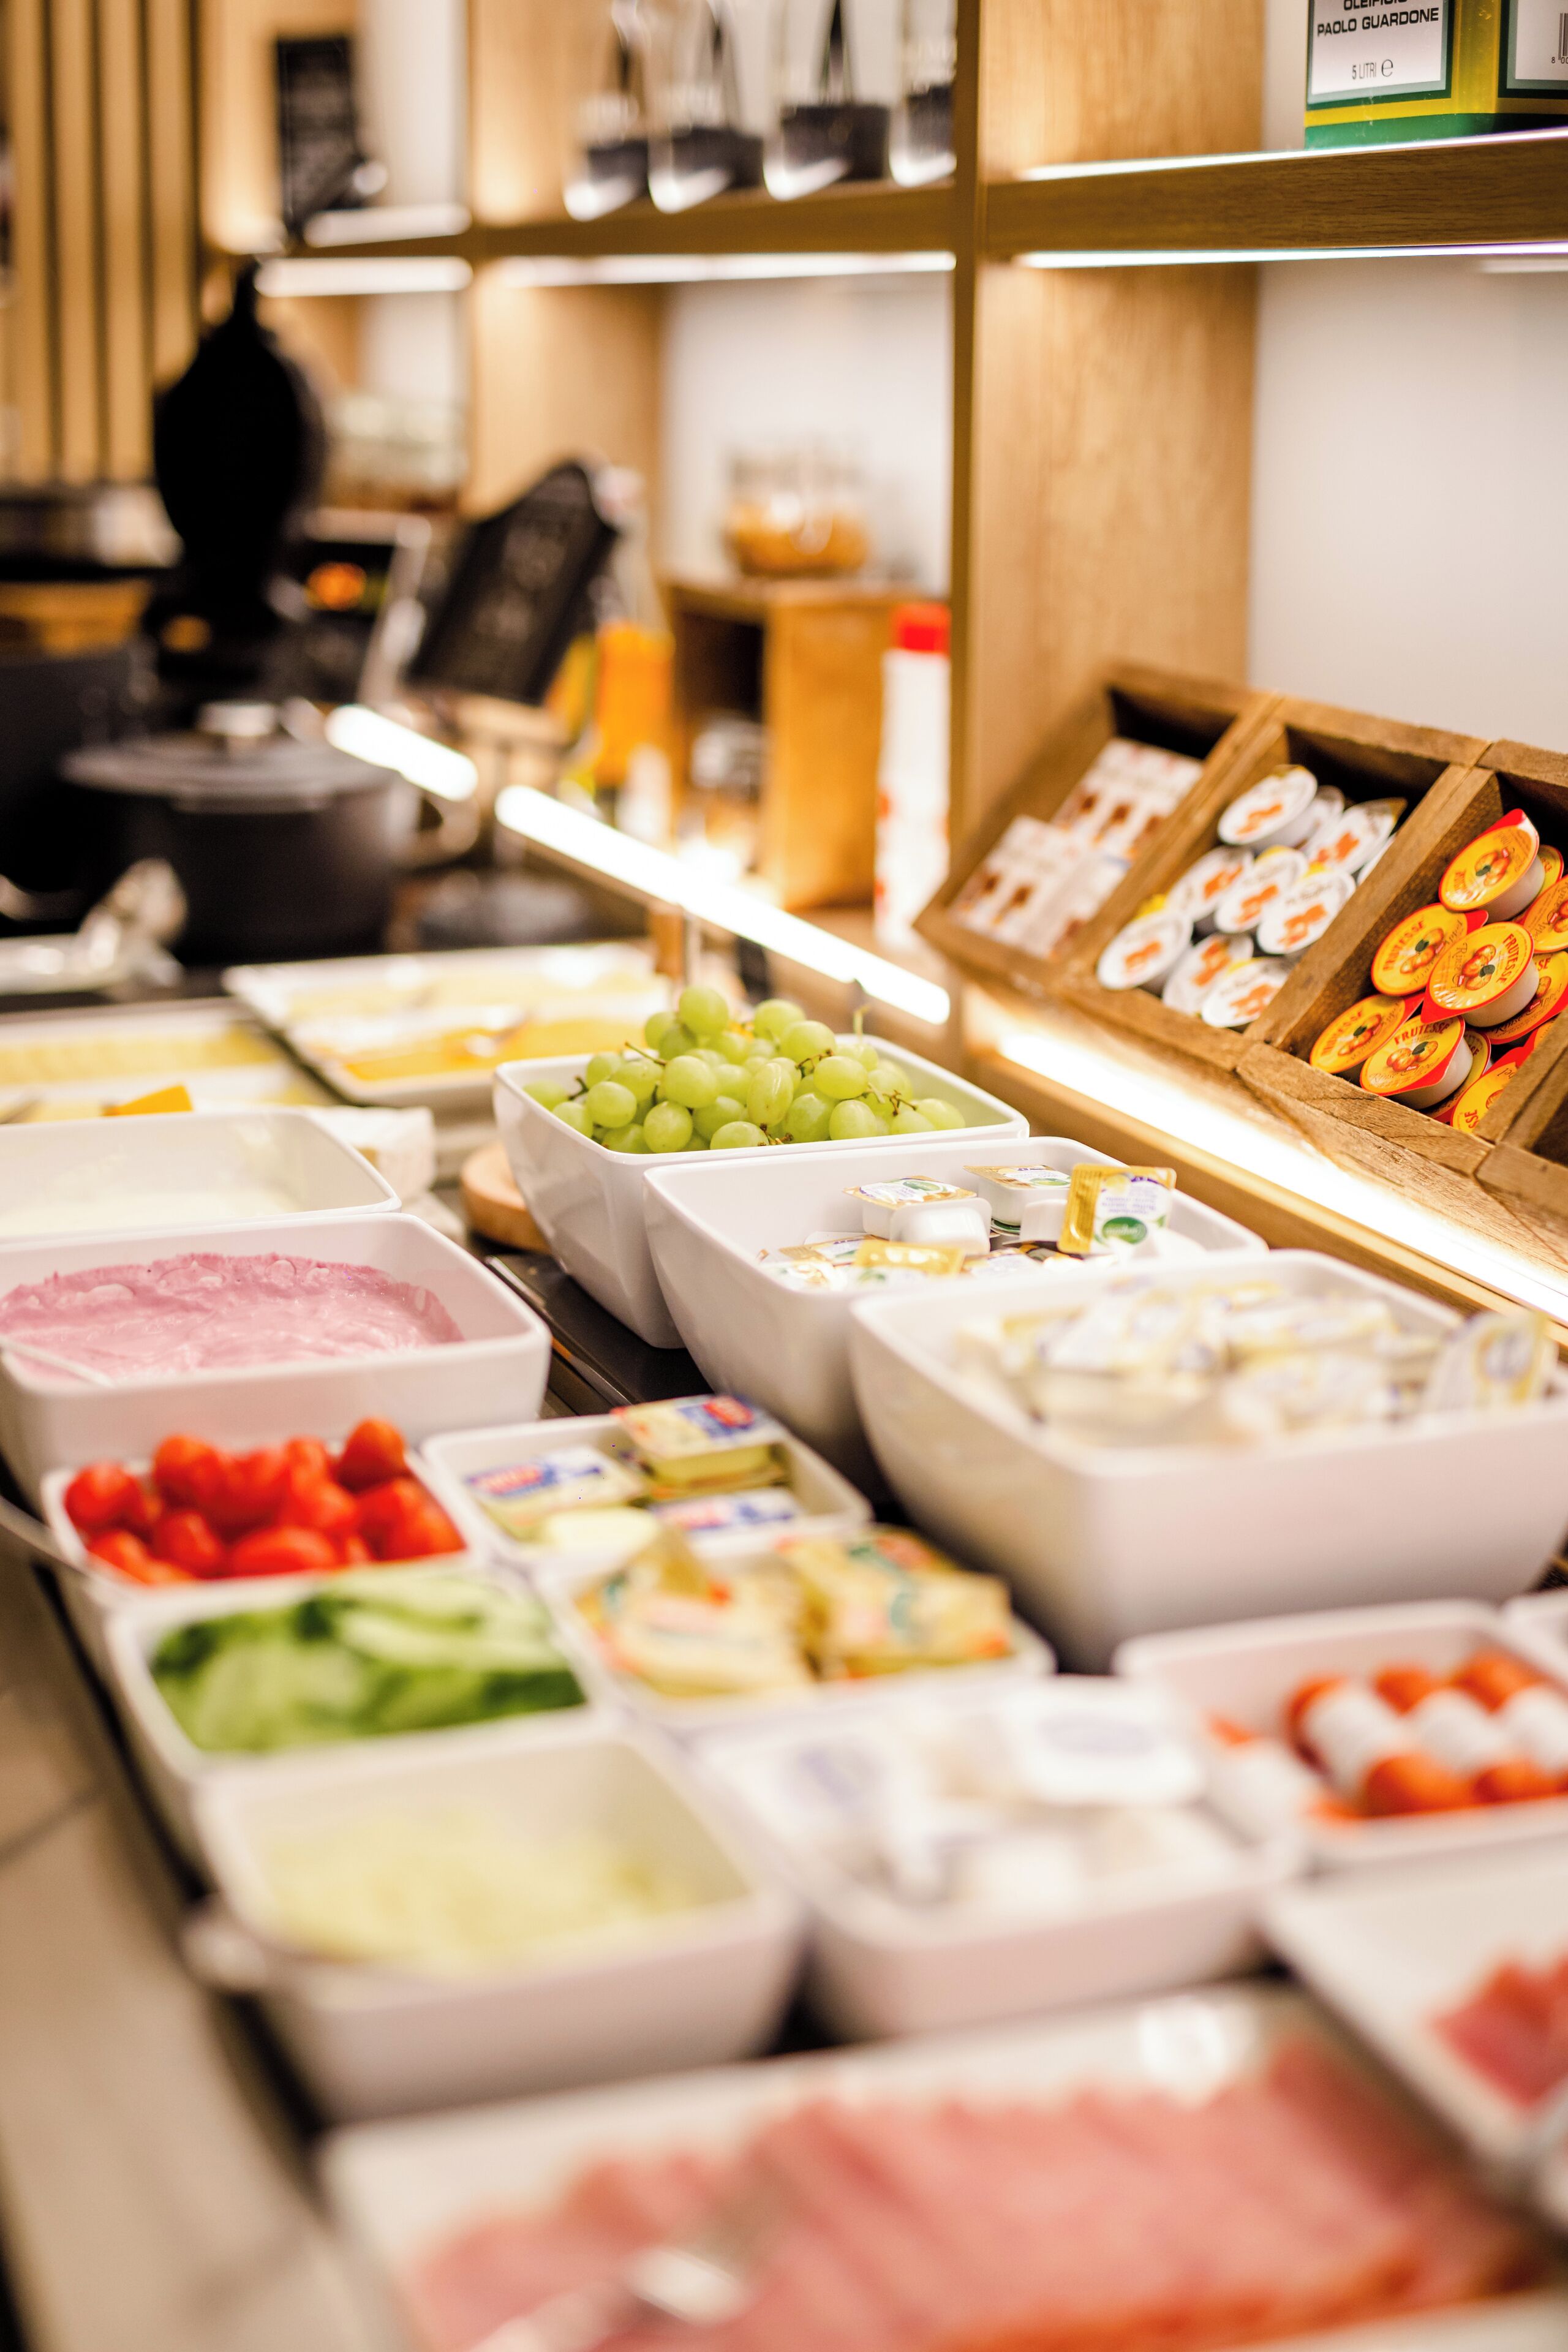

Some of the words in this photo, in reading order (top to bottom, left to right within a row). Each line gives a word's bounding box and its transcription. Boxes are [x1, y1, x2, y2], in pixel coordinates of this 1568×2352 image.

[1317, 19, 1357, 37] PAOLO
[1362, 7, 1439, 29] GUARDONE
[1352, 65, 1357, 80] 5
[1359, 62, 1376, 79] LITRI
[1496, 933, 1520, 984] FRUTESSE
[1394, 1022, 1450, 1046] FRUTESSE
